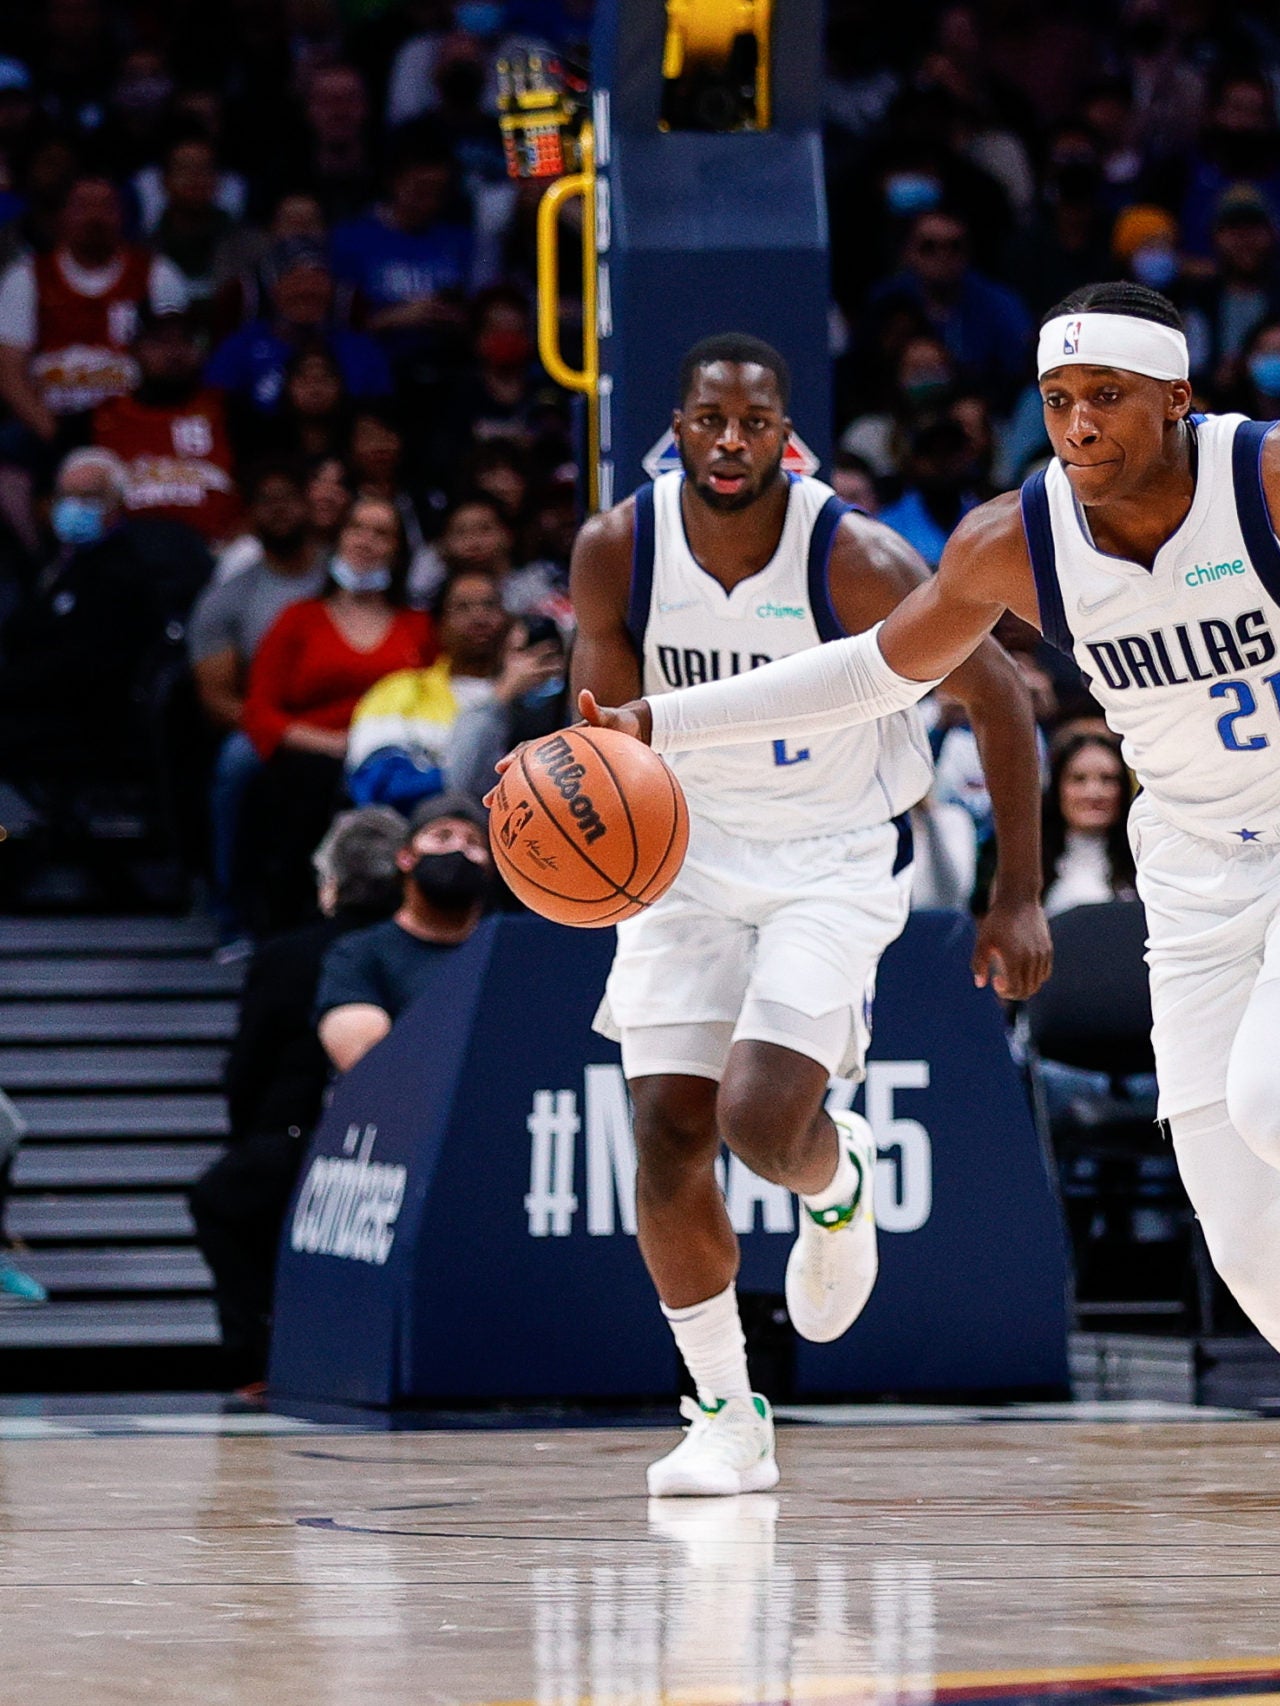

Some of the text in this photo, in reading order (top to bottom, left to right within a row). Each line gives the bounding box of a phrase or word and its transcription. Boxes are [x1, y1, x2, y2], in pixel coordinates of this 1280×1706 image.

[1185, 557, 1246, 588] chime
[756, 602, 806, 620] chime
[1084, 609, 1277, 690] DALLAS
[536, 735, 607, 846] Wilson
